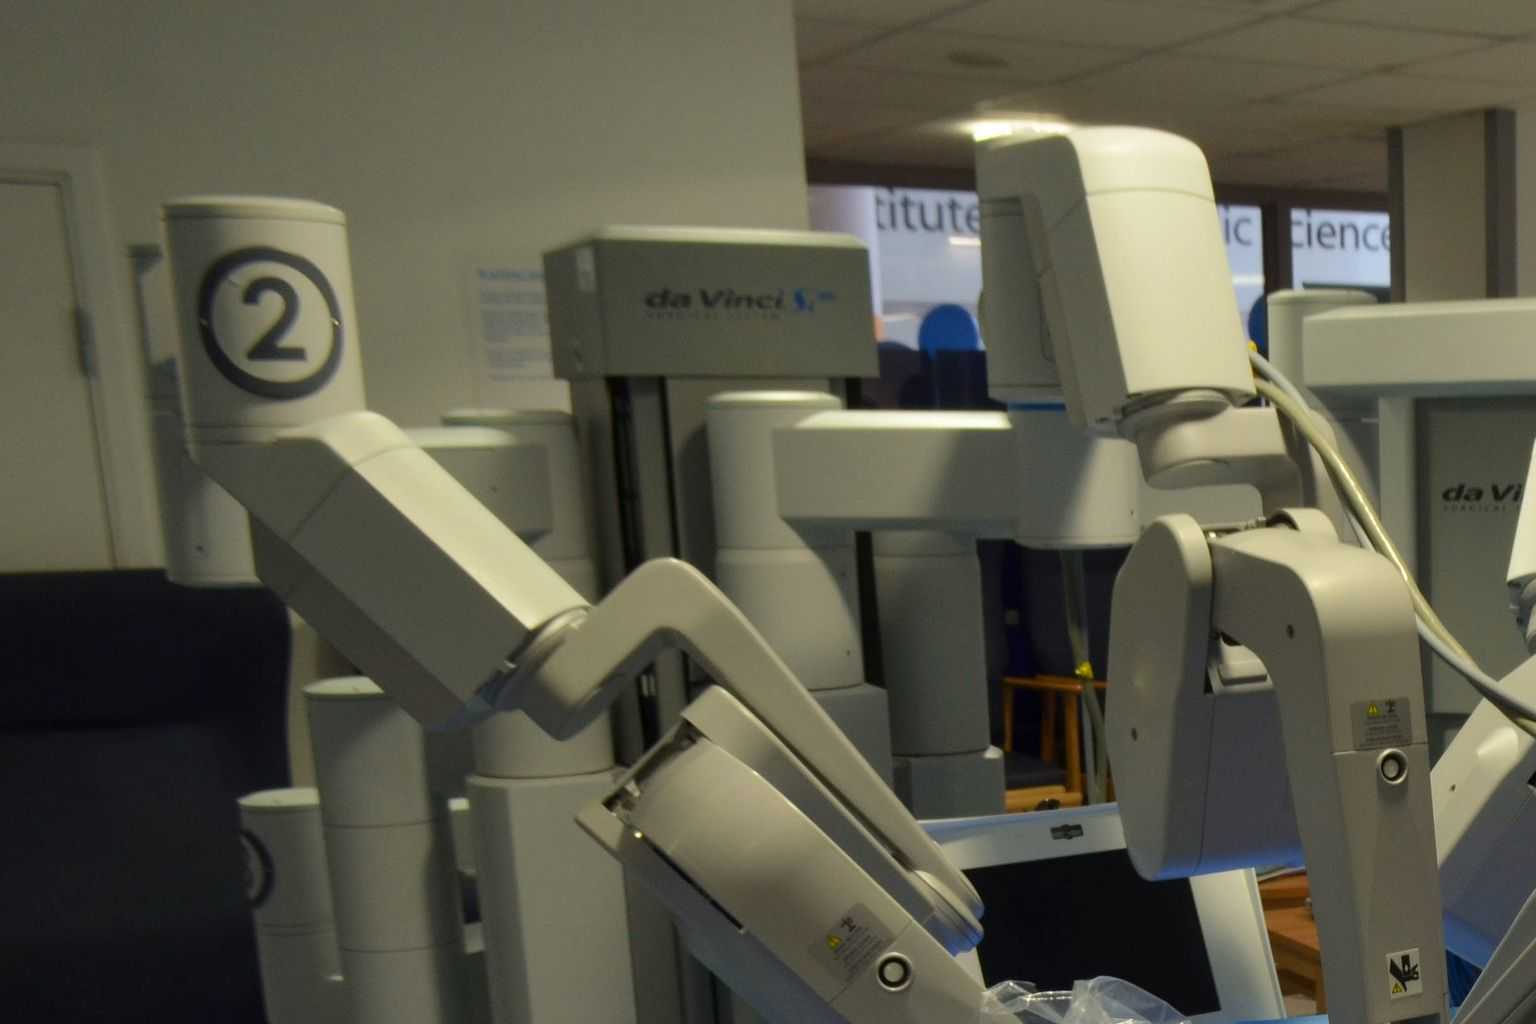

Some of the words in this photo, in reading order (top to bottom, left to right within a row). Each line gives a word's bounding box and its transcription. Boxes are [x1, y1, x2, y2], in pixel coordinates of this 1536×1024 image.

[644, 287, 692, 309] da
[699, 287, 785, 309] Vinci
[242, 276, 308, 362] 2
[1441, 483, 1484, 502] da
